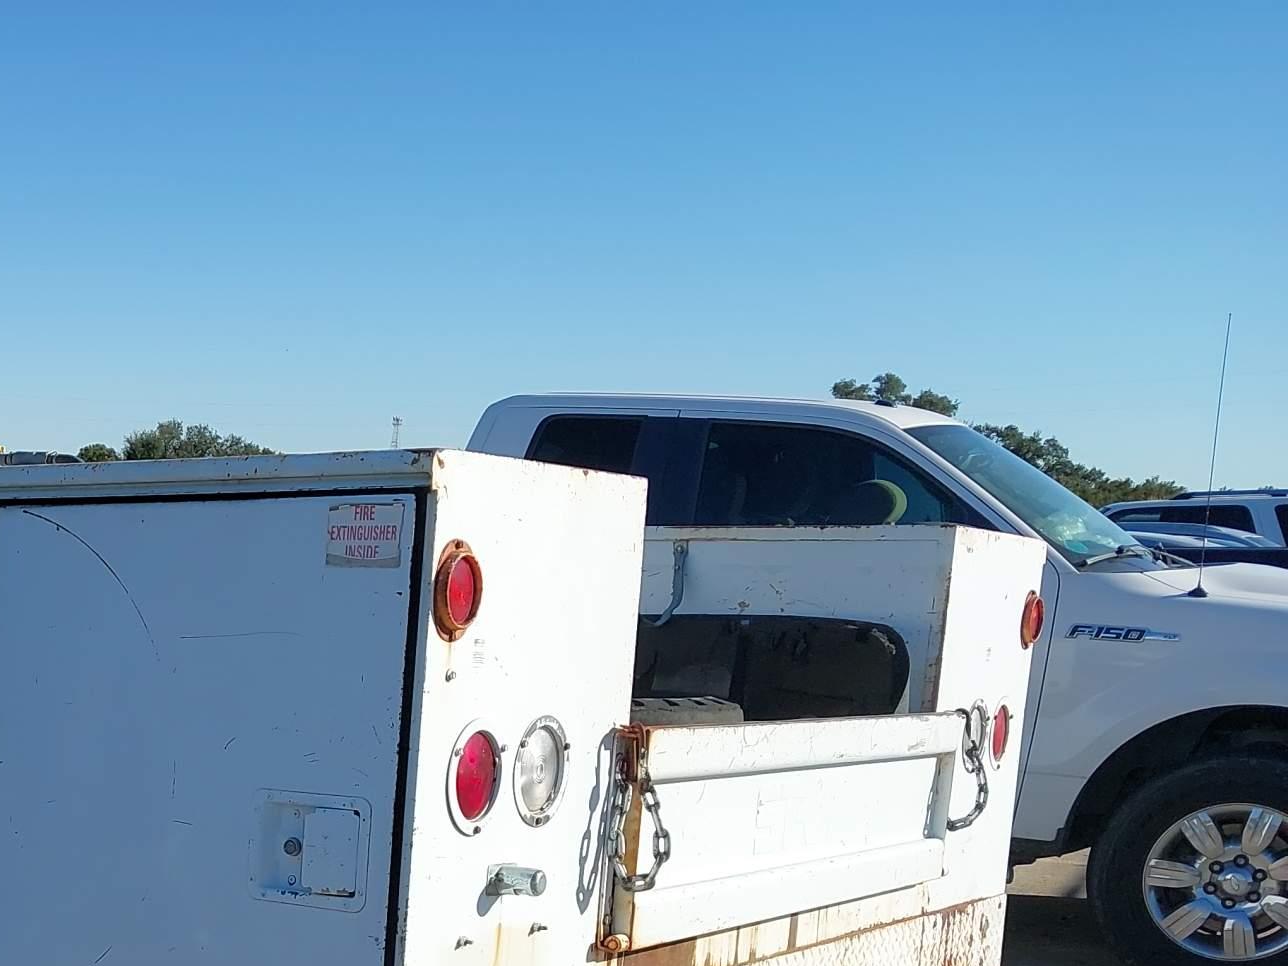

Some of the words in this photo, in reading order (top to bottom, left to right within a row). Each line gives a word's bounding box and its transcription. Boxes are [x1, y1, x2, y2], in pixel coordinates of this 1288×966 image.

[353, 504, 376, 521] FIRE
[330, 524, 398, 542] EXTINGUISHER
[345, 544, 380, 559] INSIDE
[1064, 623, 1145, 643] F-150
